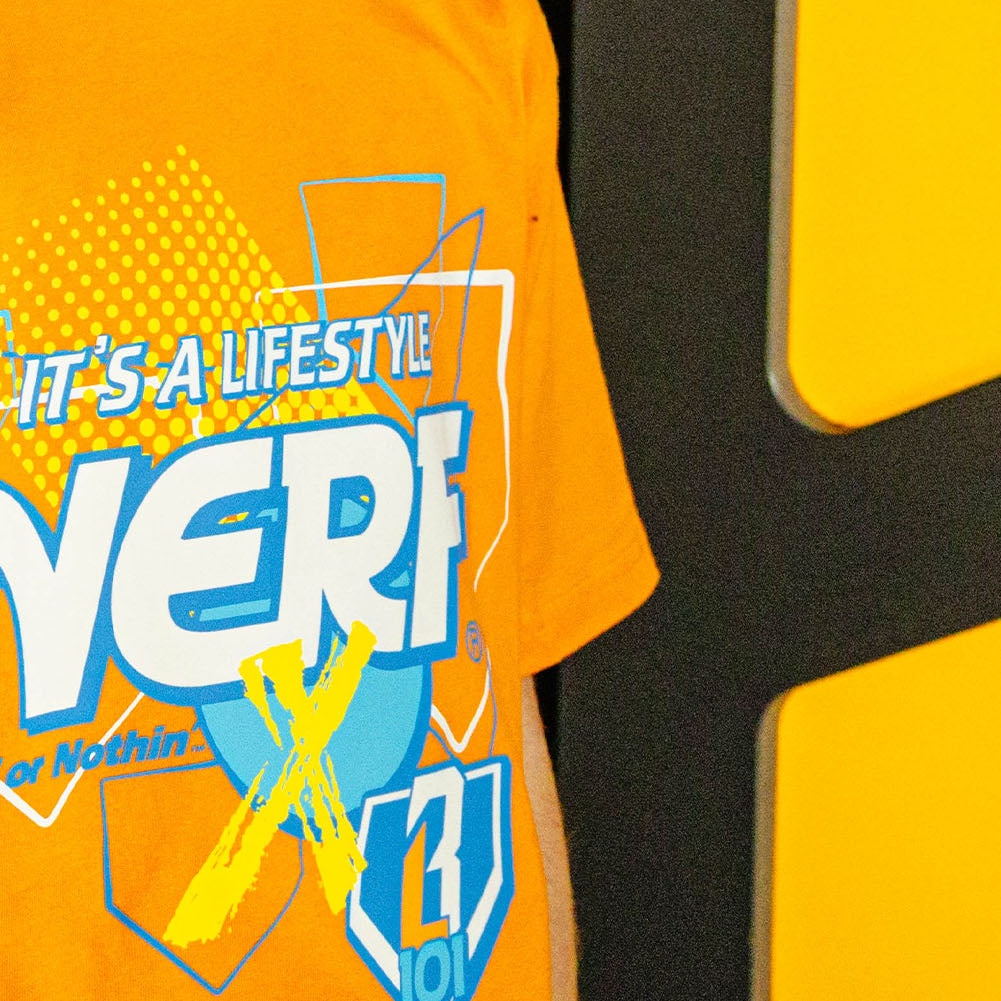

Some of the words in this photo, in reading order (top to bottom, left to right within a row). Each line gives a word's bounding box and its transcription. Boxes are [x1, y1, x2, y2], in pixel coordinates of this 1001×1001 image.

[18, 335, 147, 427] IT'S
[156, 336, 202, 405] A
[221, 311, 432, 396] LIFESTYLE
[5, 756, 46, 790] or
